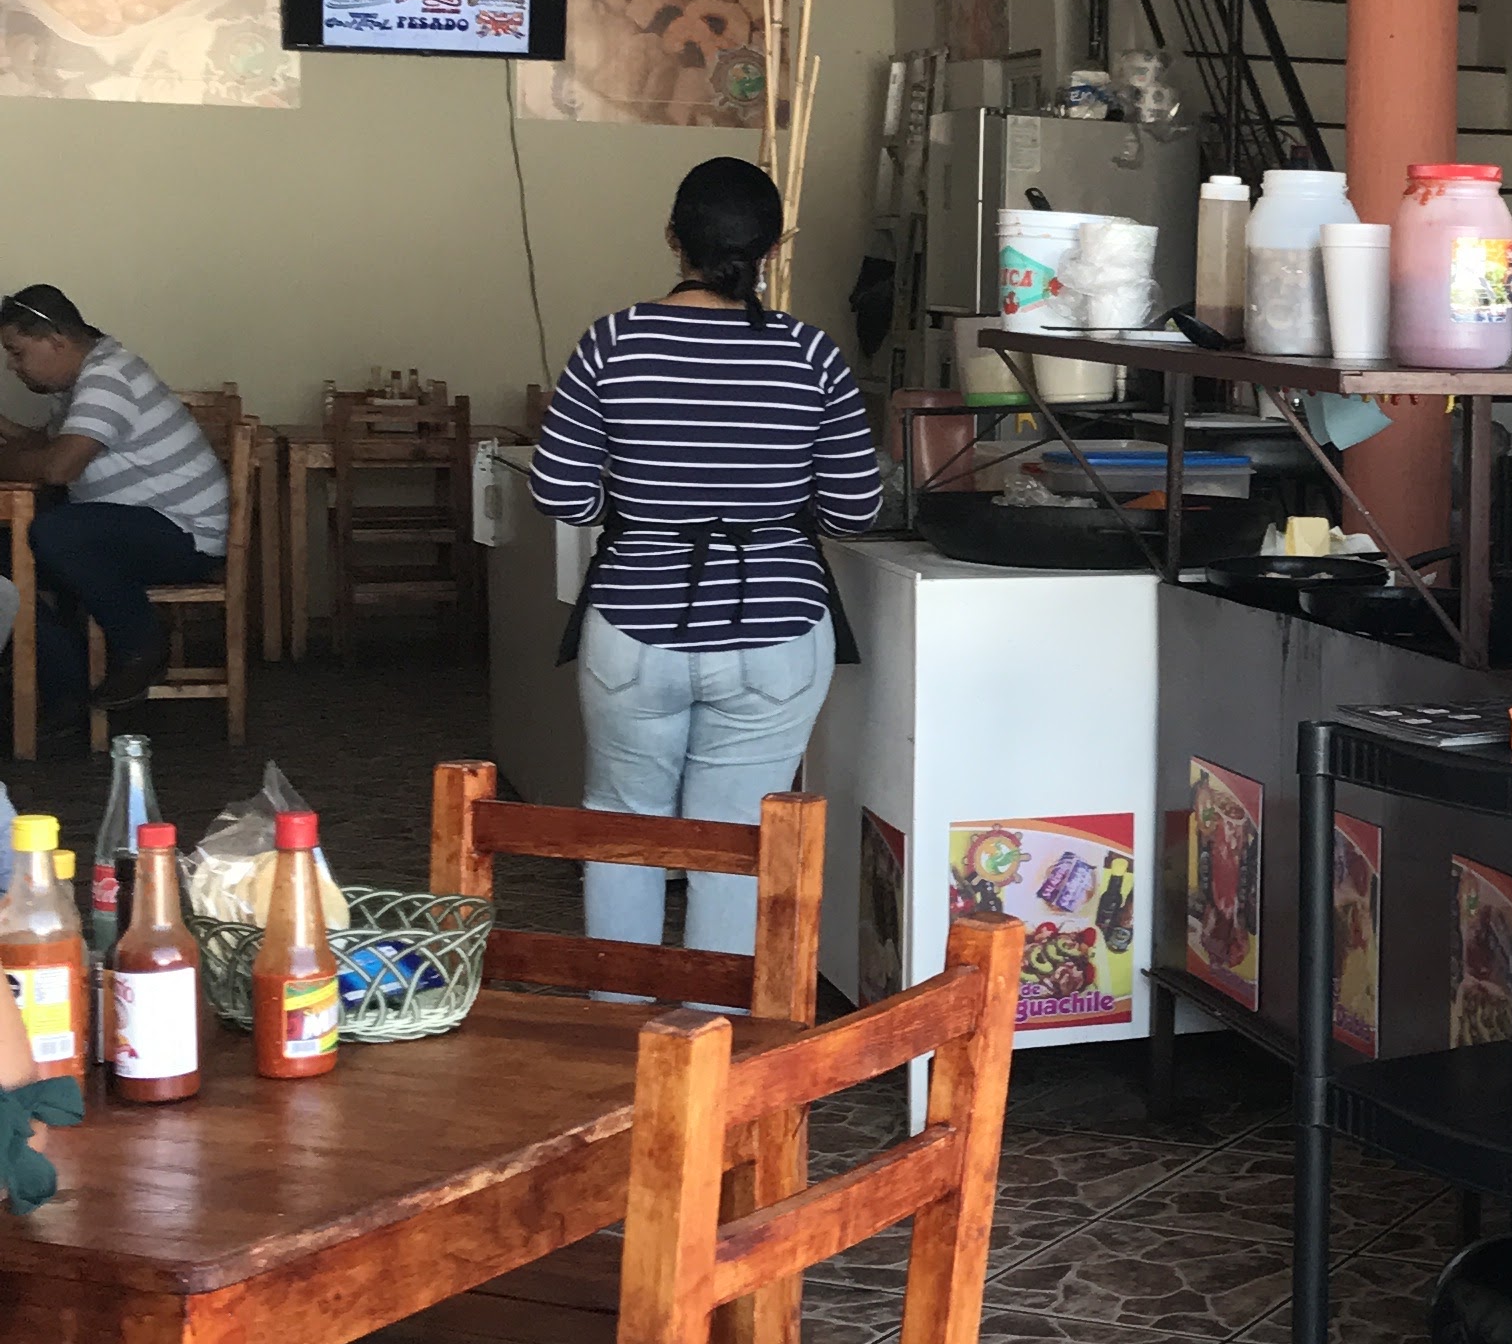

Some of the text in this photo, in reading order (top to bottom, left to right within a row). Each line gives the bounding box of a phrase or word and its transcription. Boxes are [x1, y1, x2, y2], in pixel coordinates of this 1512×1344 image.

[396, 16, 469, 31] PESADO
[1021, 983, 1040, 996] de
[1014, 992, 1117, 1023] guachile
